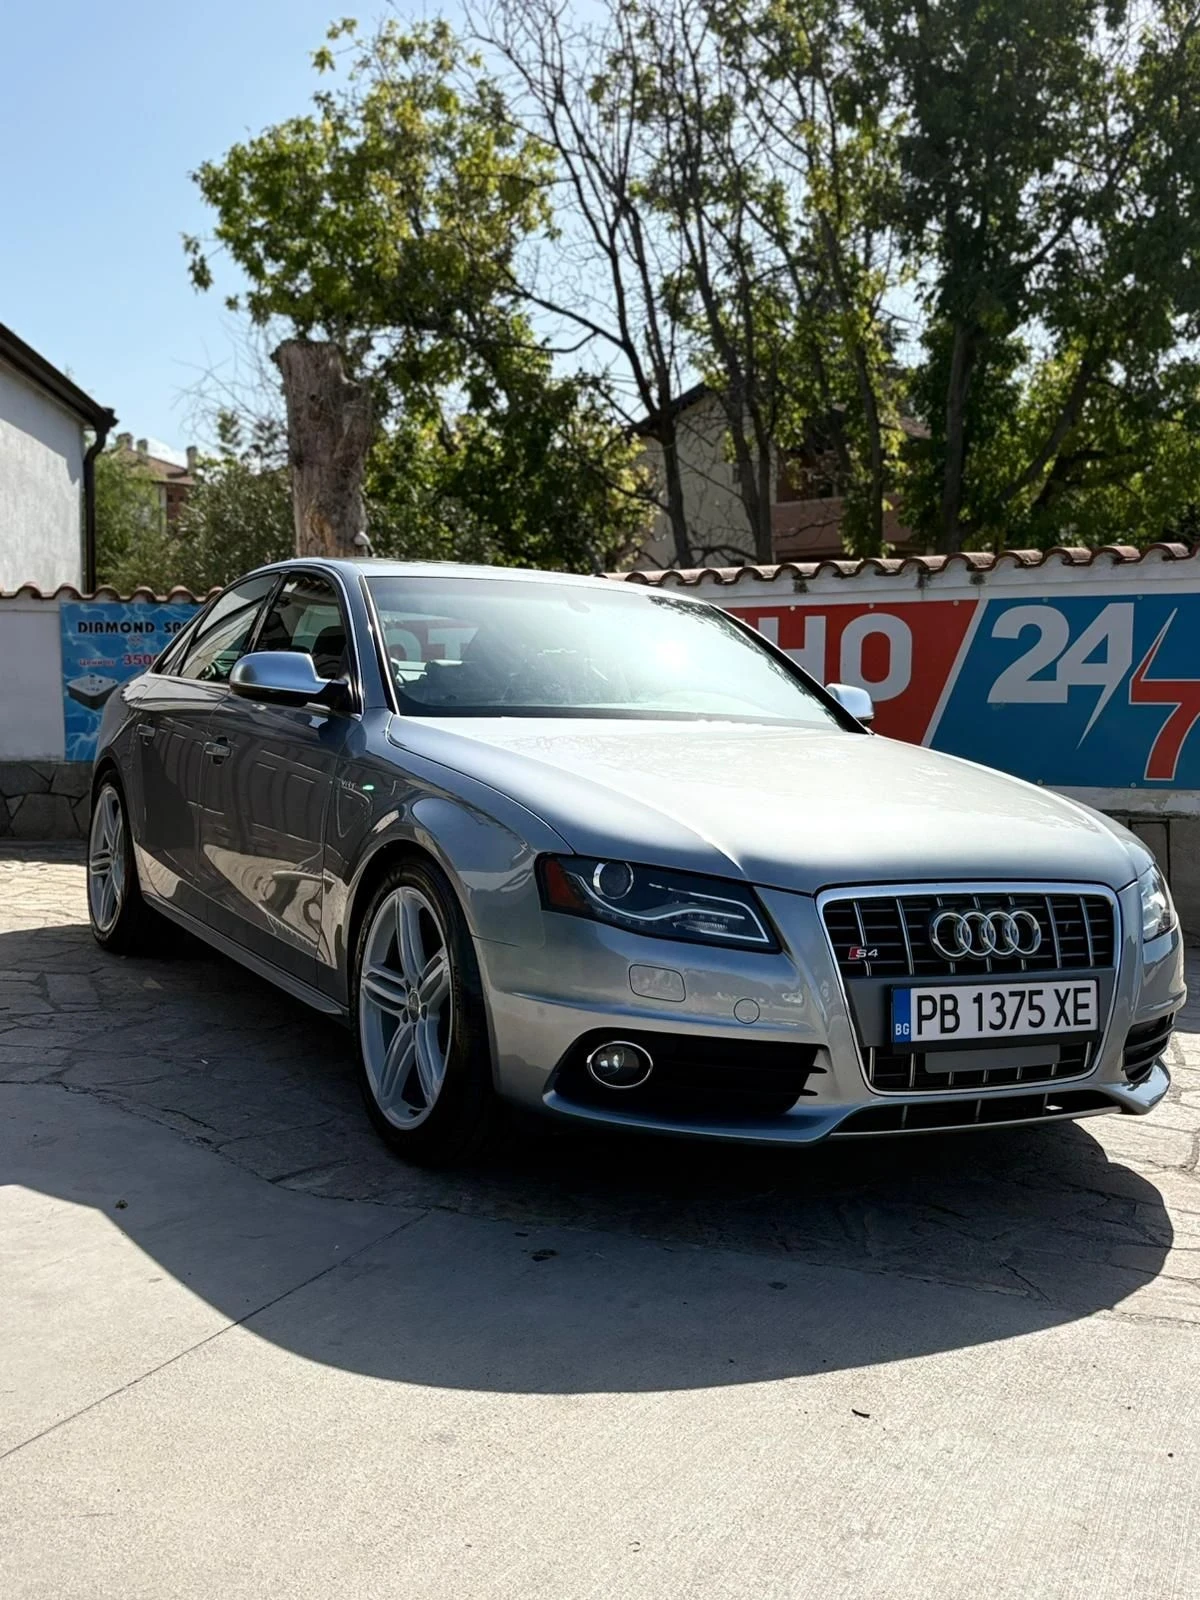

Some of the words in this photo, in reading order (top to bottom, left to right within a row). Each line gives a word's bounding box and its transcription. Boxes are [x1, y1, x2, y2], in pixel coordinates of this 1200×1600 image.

[78, 621, 155, 634] DIAMOND
[163, 621, 187, 634] SP
[853, 948, 879, 958] S4
[916, 993, 960, 1036] PB
[972, 989, 1046, 1032] 1375
[1053, 987, 1091, 1027] XE
[895, 1023, 910, 1036] BG
